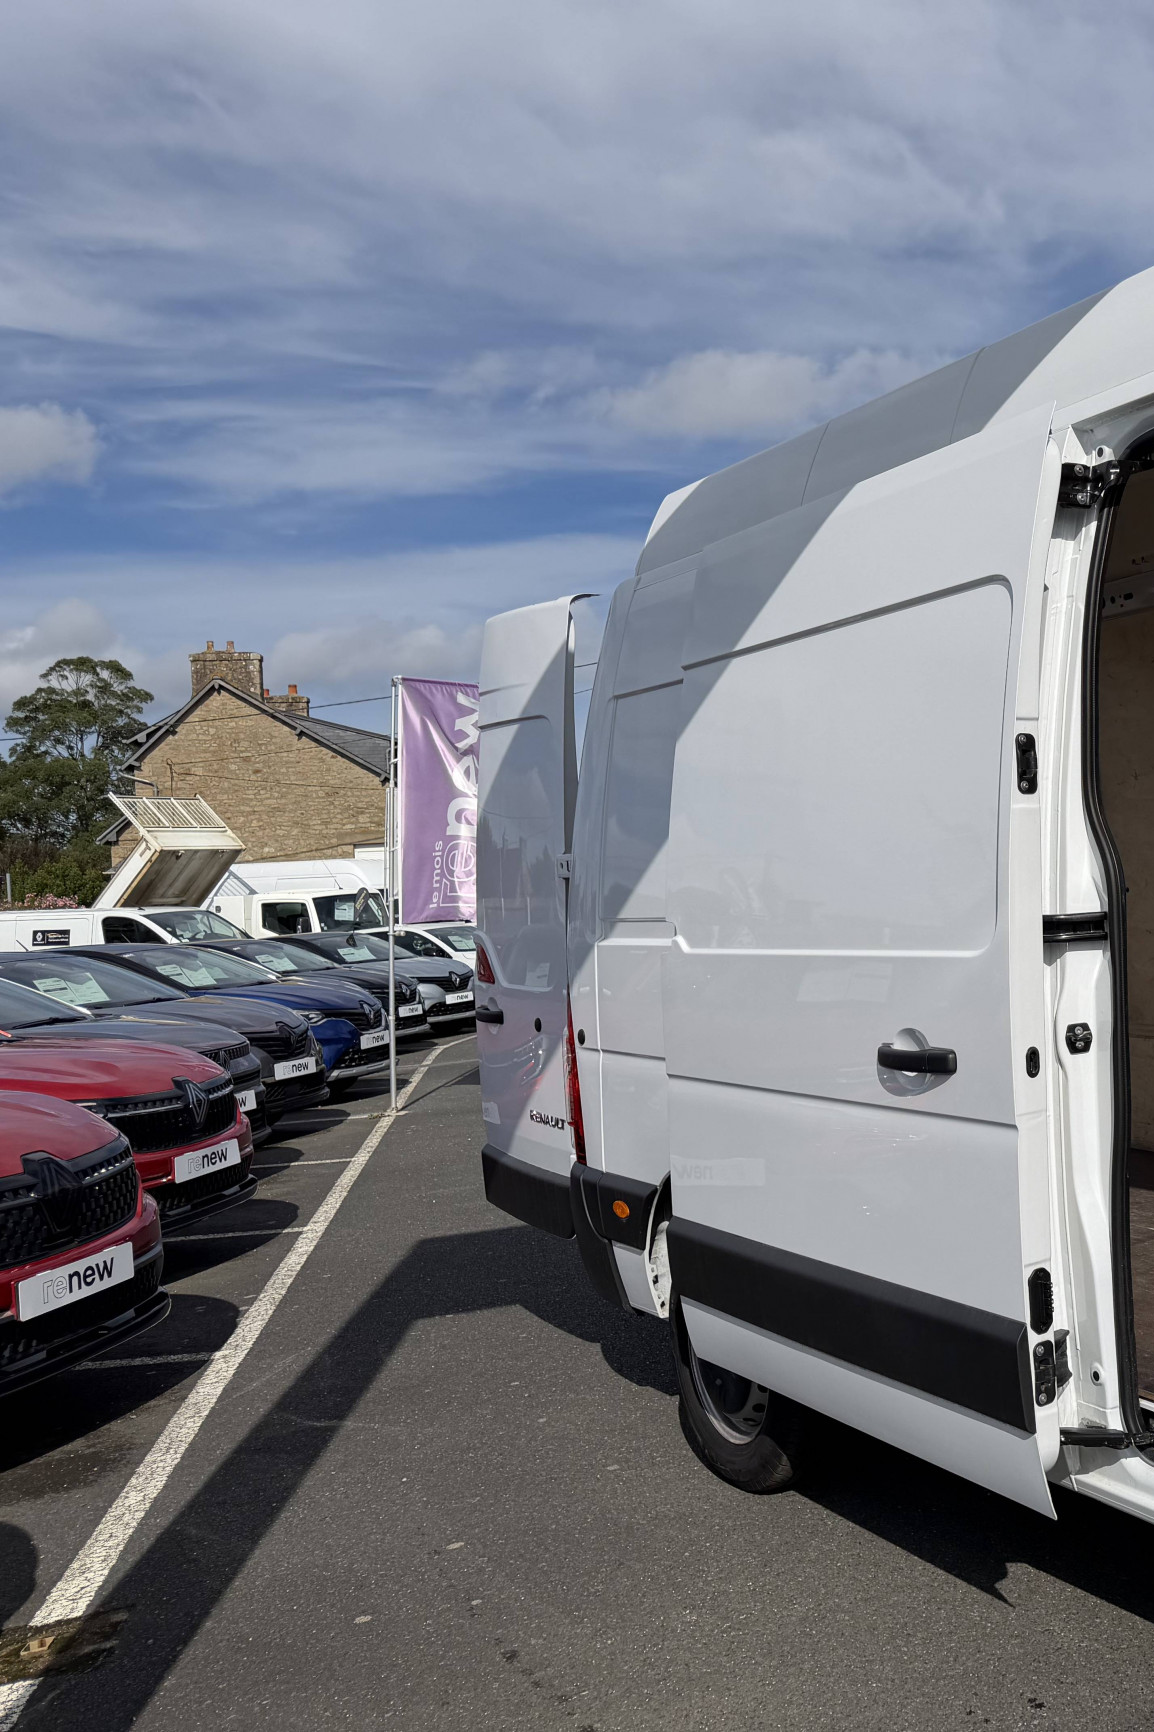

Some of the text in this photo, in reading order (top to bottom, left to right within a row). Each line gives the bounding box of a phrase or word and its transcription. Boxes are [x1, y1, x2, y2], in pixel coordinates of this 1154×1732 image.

[429, 840, 443, 909] le mois
[530, 1110, 566, 1130] RENAULT
[188, 1148, 228, 1174] renew
[43, 1257, 114, 1304] renew
